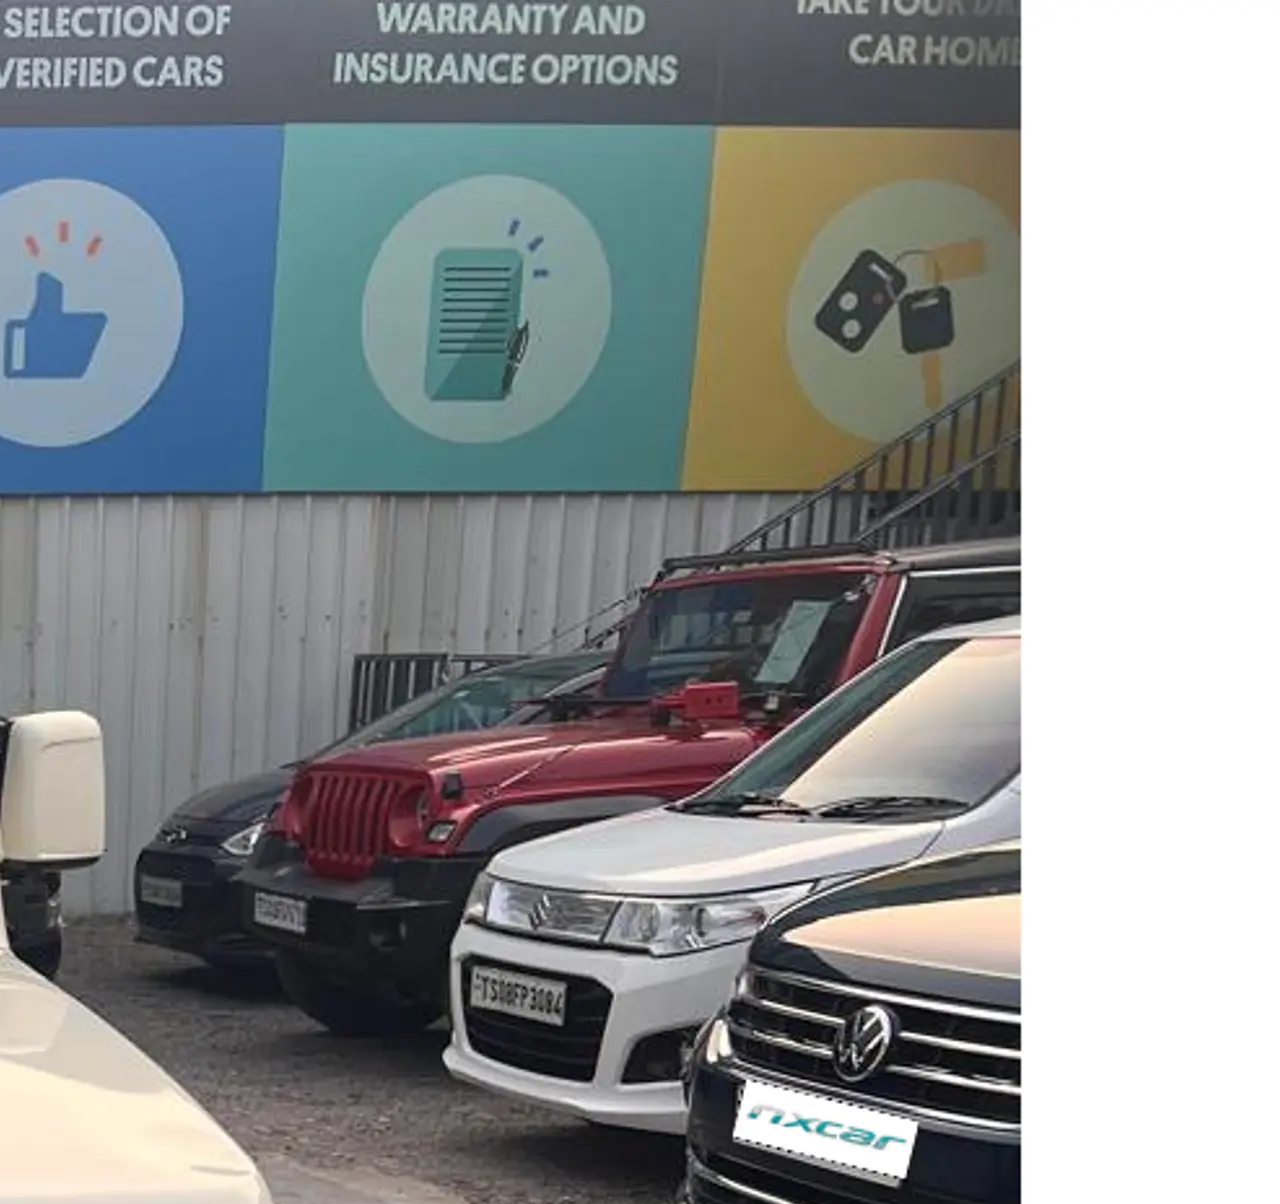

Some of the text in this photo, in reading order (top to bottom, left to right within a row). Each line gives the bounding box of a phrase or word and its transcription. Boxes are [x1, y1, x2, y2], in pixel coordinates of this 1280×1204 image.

[3, 5, 179, 38] SELECTION
[185, 5, 231, 36] OF
[377, 2, 646, 35] WARRANTY AND
[848, 34, 917, 65] CAR
[133, 54, 224, 87] CARS
[333, 52, 679, 85] INSURANCE OPTIONS
